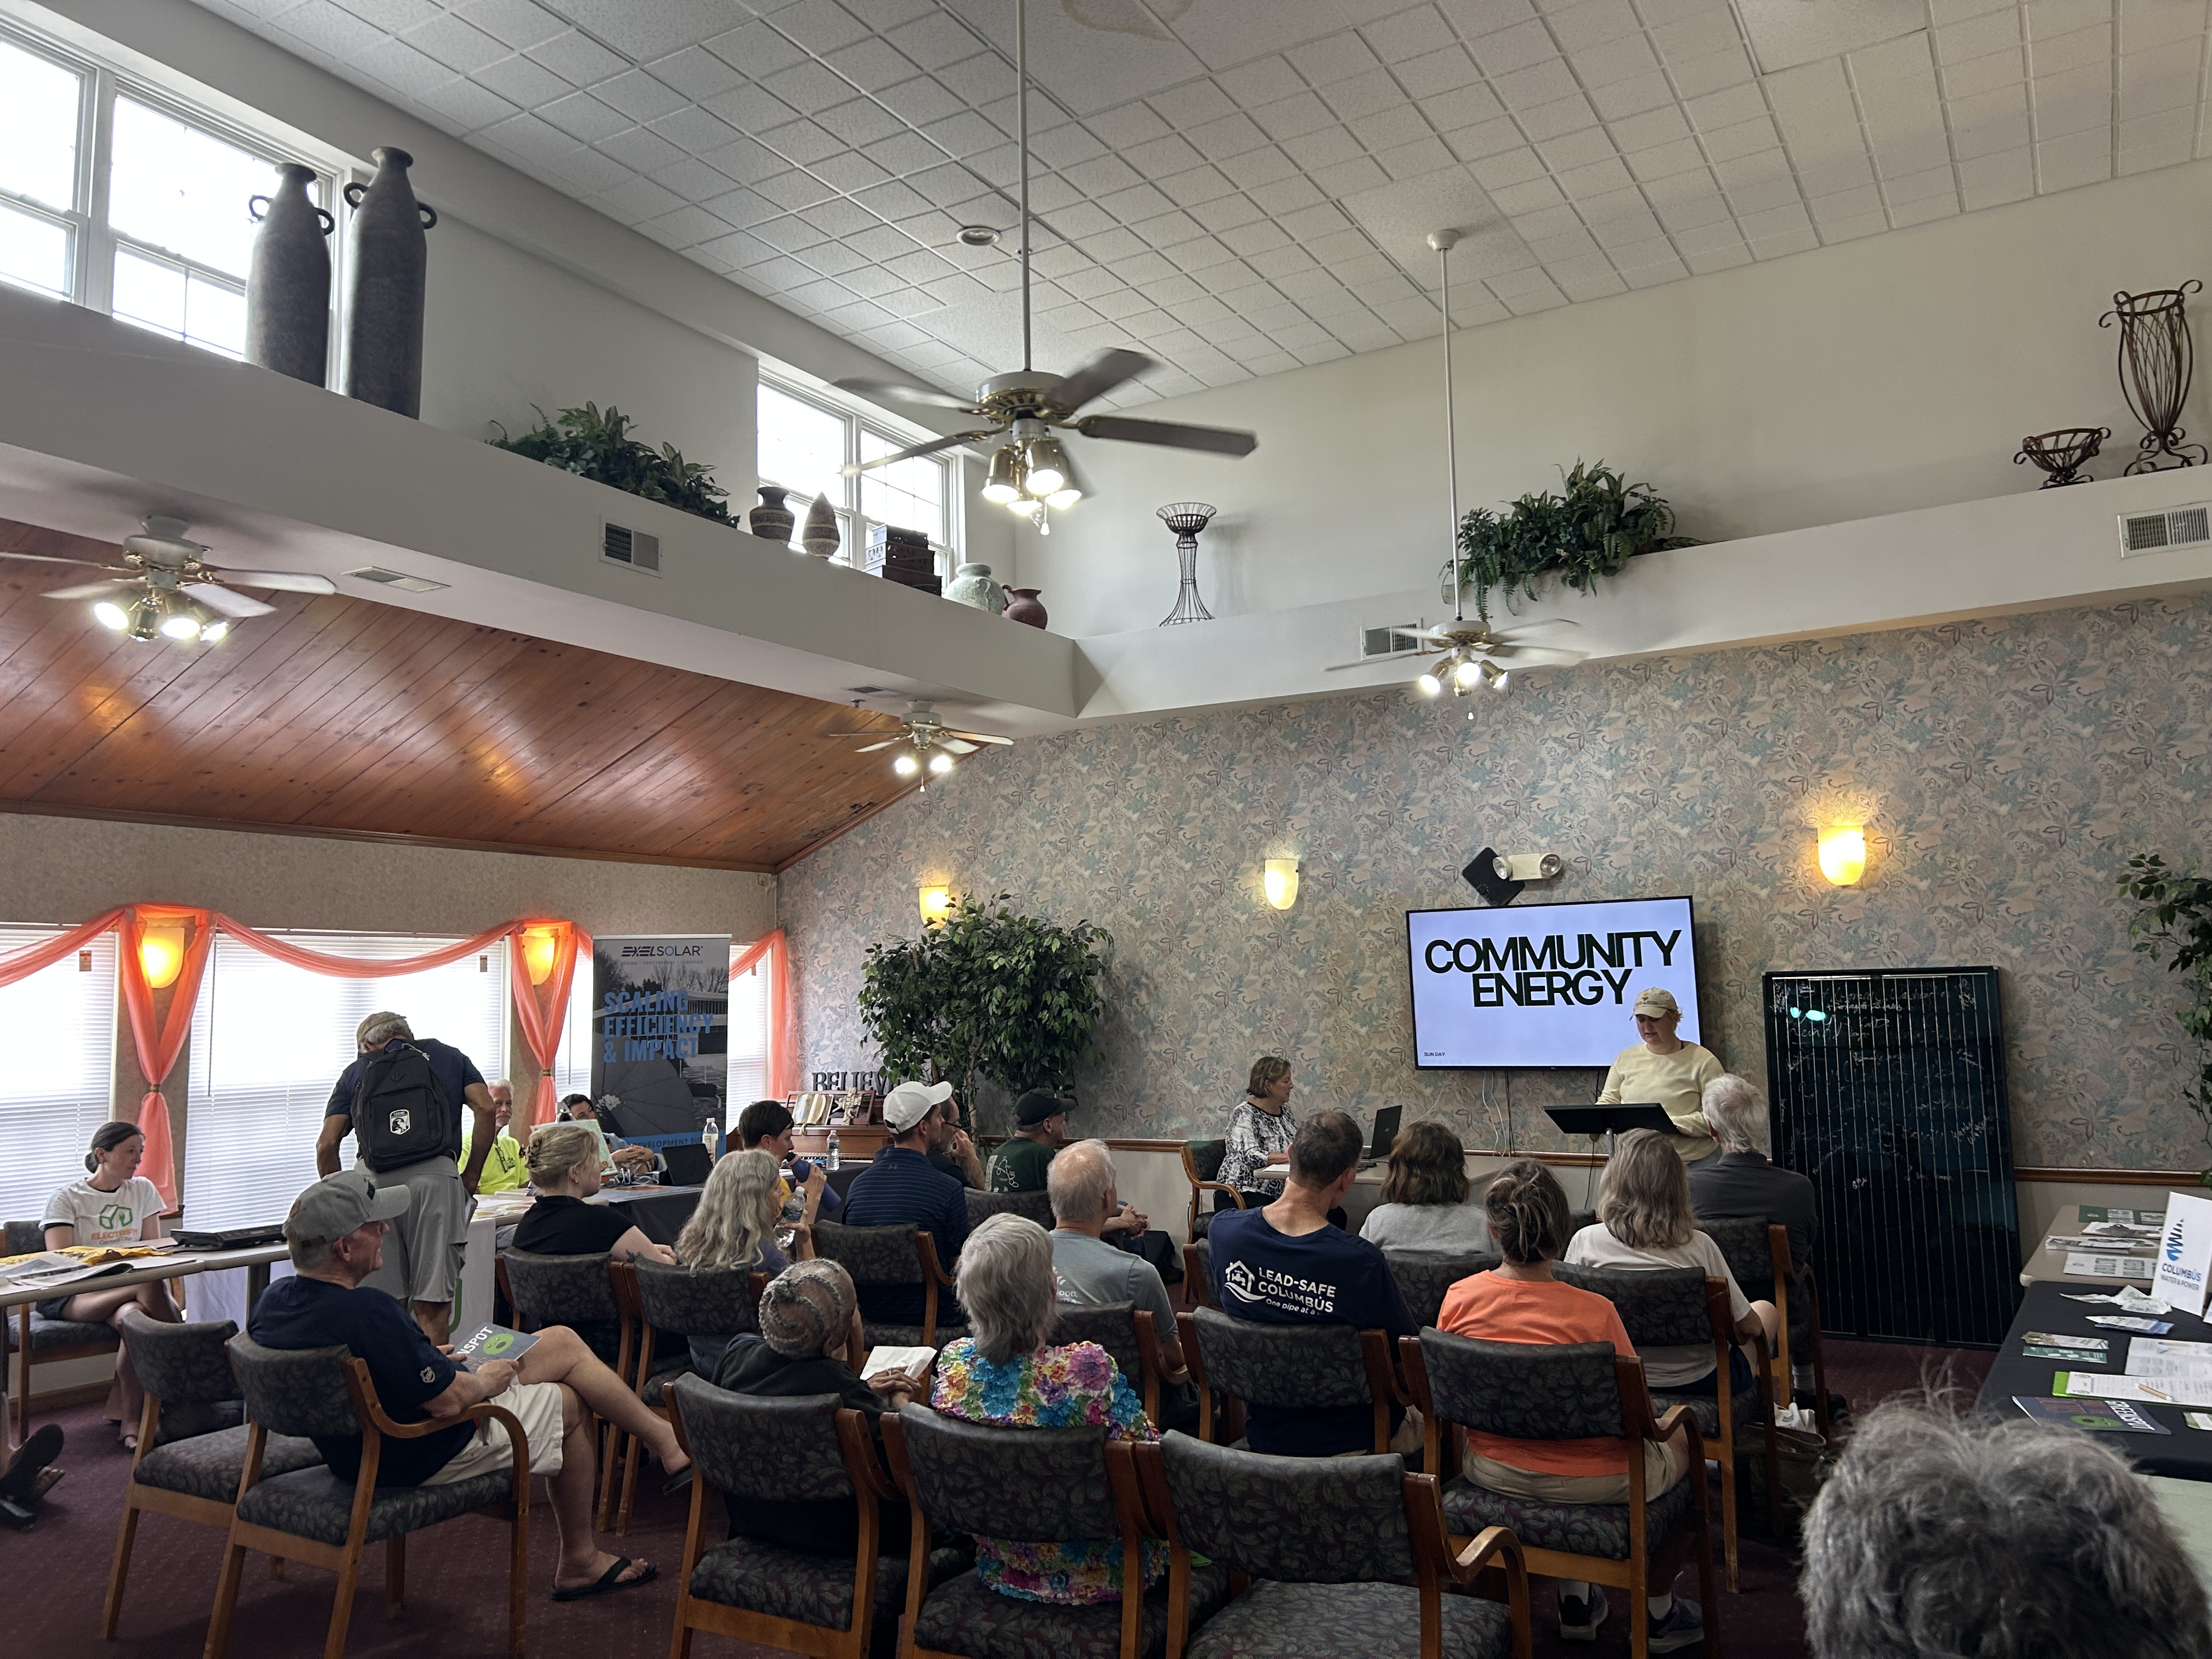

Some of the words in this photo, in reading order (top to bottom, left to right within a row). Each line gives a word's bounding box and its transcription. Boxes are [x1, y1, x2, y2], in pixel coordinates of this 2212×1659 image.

[1425, 930, 1682, 974] COMMUNITY
[1472, 968, 1633, 1007] ENERGY
[603, 989, 689, 1013] SCALING
[603, 1013, 713, 1038] EFFICIENCY
[603, 1041, 617, 1063] &
[624, 1037, 699, 1062] IMPACT
[1259, 1267, 1336, 1298] LEAD-SAFE
[2162, 1263, 2202, 1282] COLUMBUS
[1258, 1281, 1334, 1313] COLUMBUS
[1266, 1298, 1281, 1307] One
[1282, 1302, 1300, 1312] pipe
[1300, 1306, 1310, 1314] at
